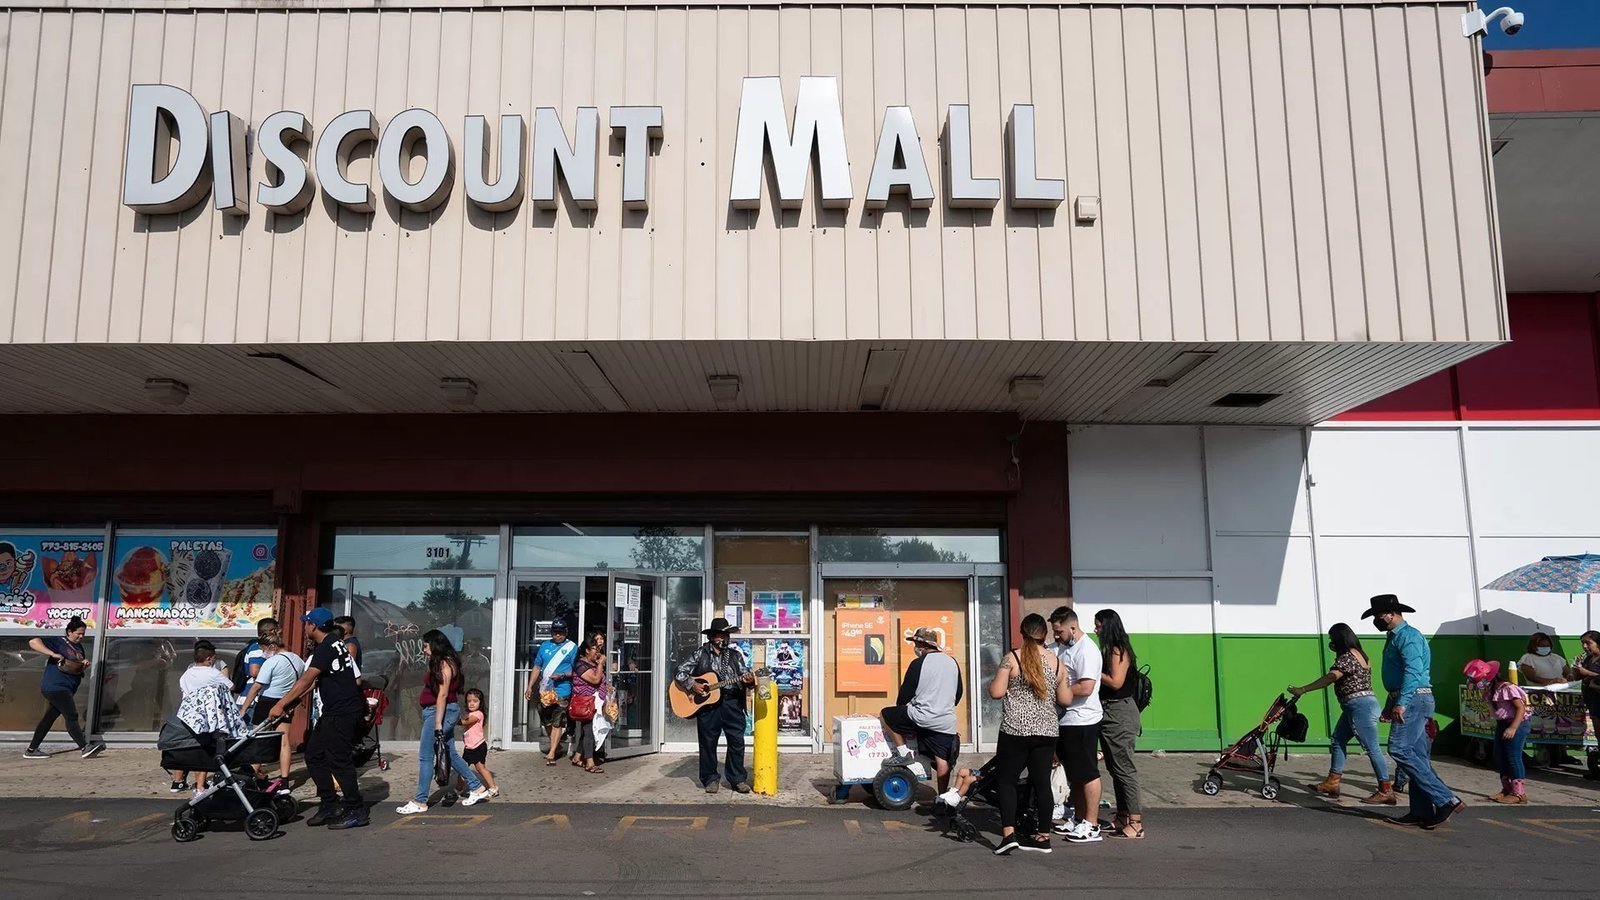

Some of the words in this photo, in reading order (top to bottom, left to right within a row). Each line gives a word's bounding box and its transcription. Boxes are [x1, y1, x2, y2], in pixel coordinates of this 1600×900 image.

[123, 83, 663, 213] DISCOUNT
[729, 75, 1066, 209] MALL
[170, 540, 223, 551] PALETAS
[426, 547, 450, 558] 3101
[47, 608, 90, 619] YOGURT
[116, 608, 196, 619] MANGONADAS
